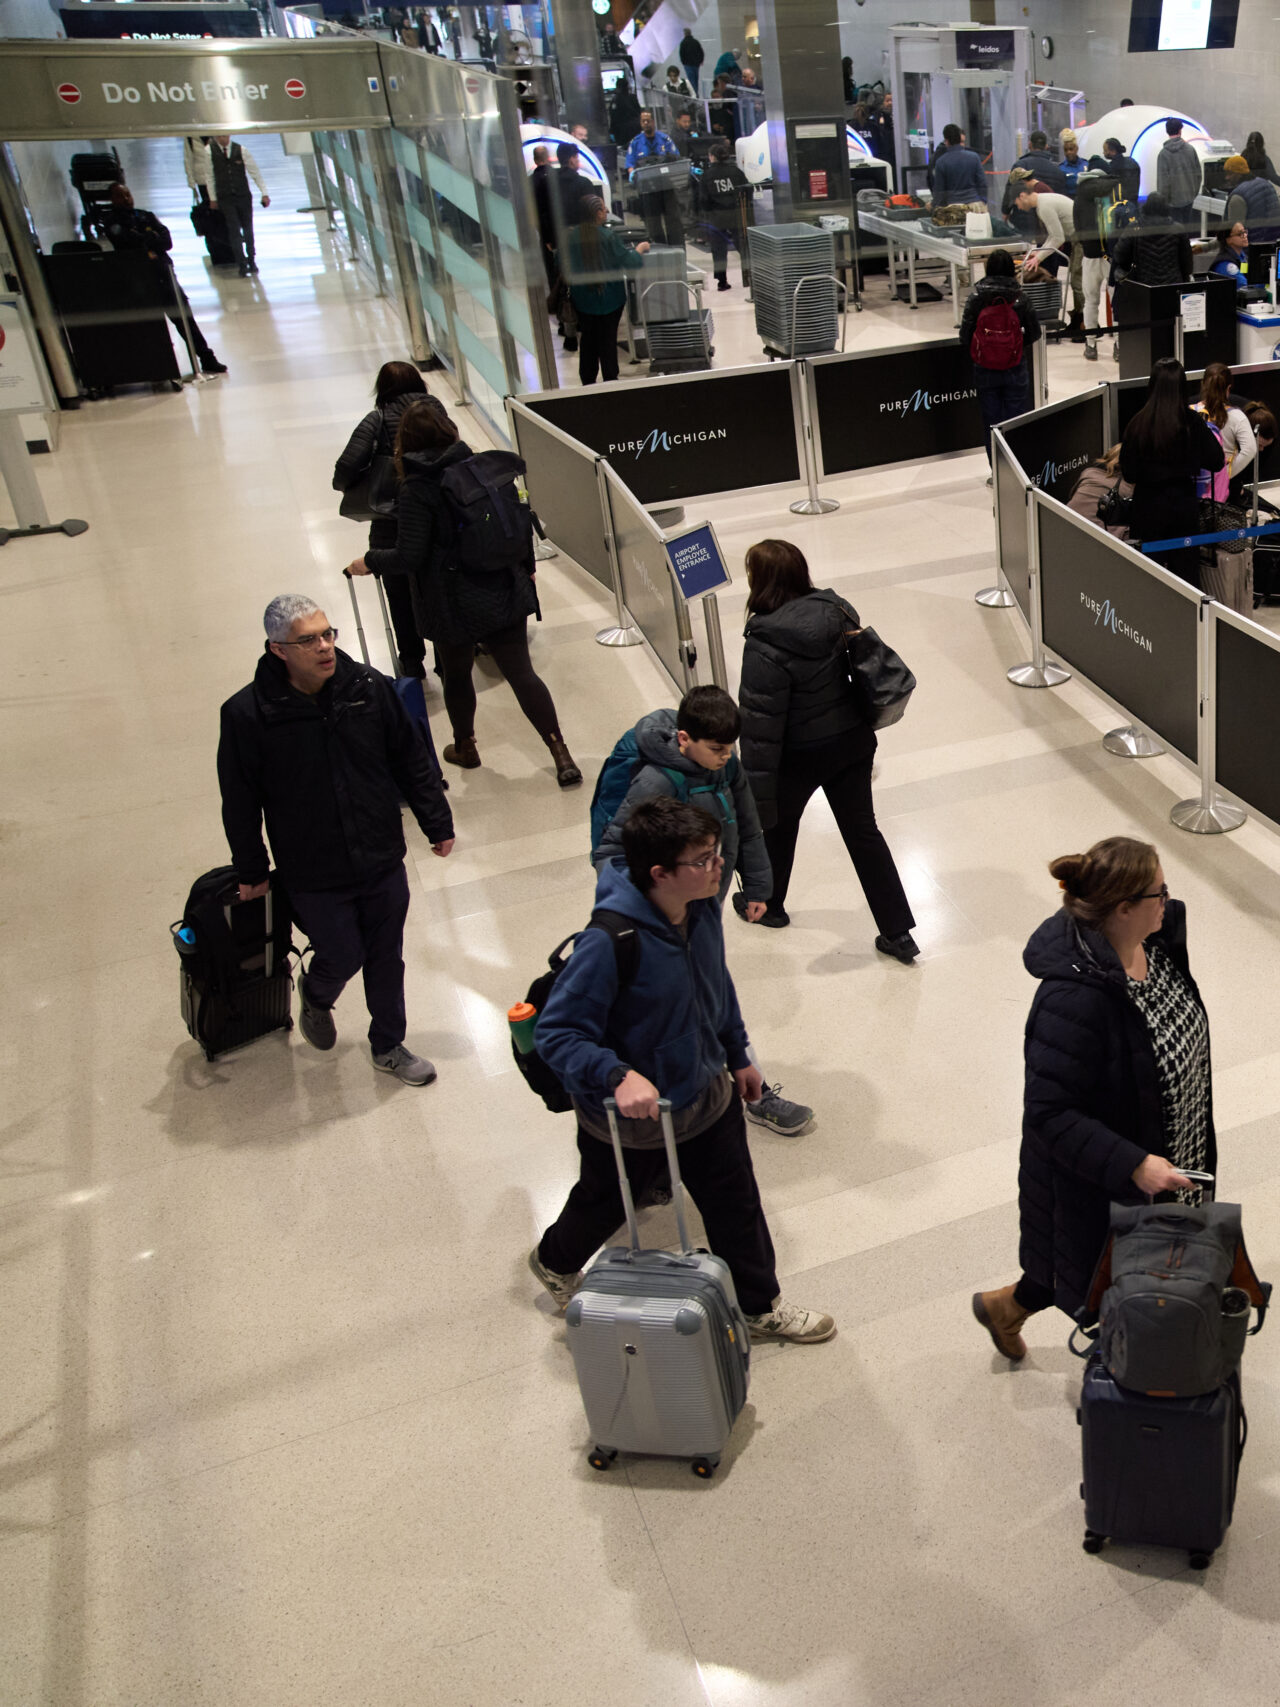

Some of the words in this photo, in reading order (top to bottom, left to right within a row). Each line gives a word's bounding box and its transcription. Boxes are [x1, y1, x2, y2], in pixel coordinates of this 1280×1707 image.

[978, 45, 1000, 53] leidos
[101, 82, 141, 103] Do
[146, 81, 196, 103] Not
[200, 80, 269, 102] Enter
[714, 178, 734, 194] TSA
[879, 399, 910, 413] PURE
[901, 389, 979, 418] MICHIGAN
[608, 440, 644, 454] PURE
[635, 428, 728, 460] MICHIGAN
[1041, 454, 1090, 487] MICHIGAN
[674, 543, 700, 559] AIRPORT
[676, 547, 708, 565] EMPLOYEE
[678, 553, 711, 571] ENTRANCE
[1080, 592, 1101, 616] PURE
[1095, 600, 1153, 653] MICHIGAN
